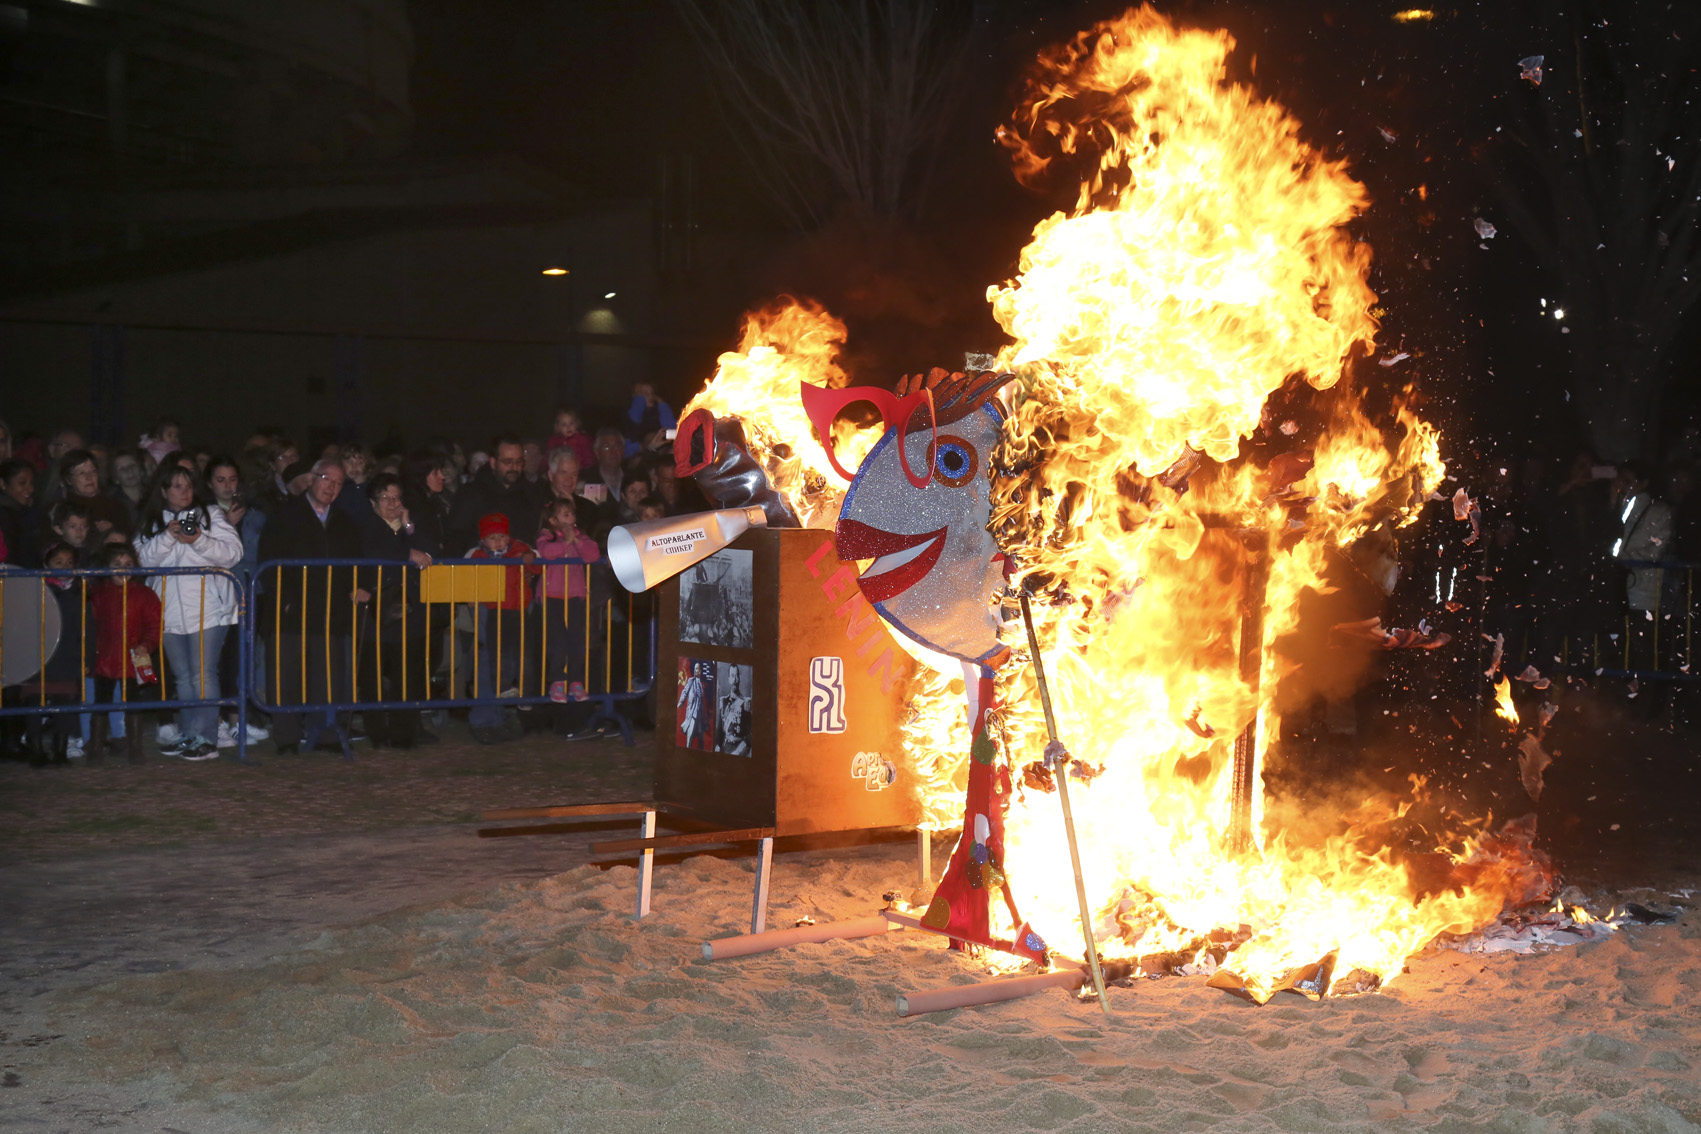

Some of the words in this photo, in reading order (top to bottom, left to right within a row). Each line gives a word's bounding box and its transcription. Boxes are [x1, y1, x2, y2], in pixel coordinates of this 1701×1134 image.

[651, 531, 705, 547] ALTOPARLANTE
[665, 543, 693, 555] СПИКЕР
[804, 539, 905, 695] LENIN
